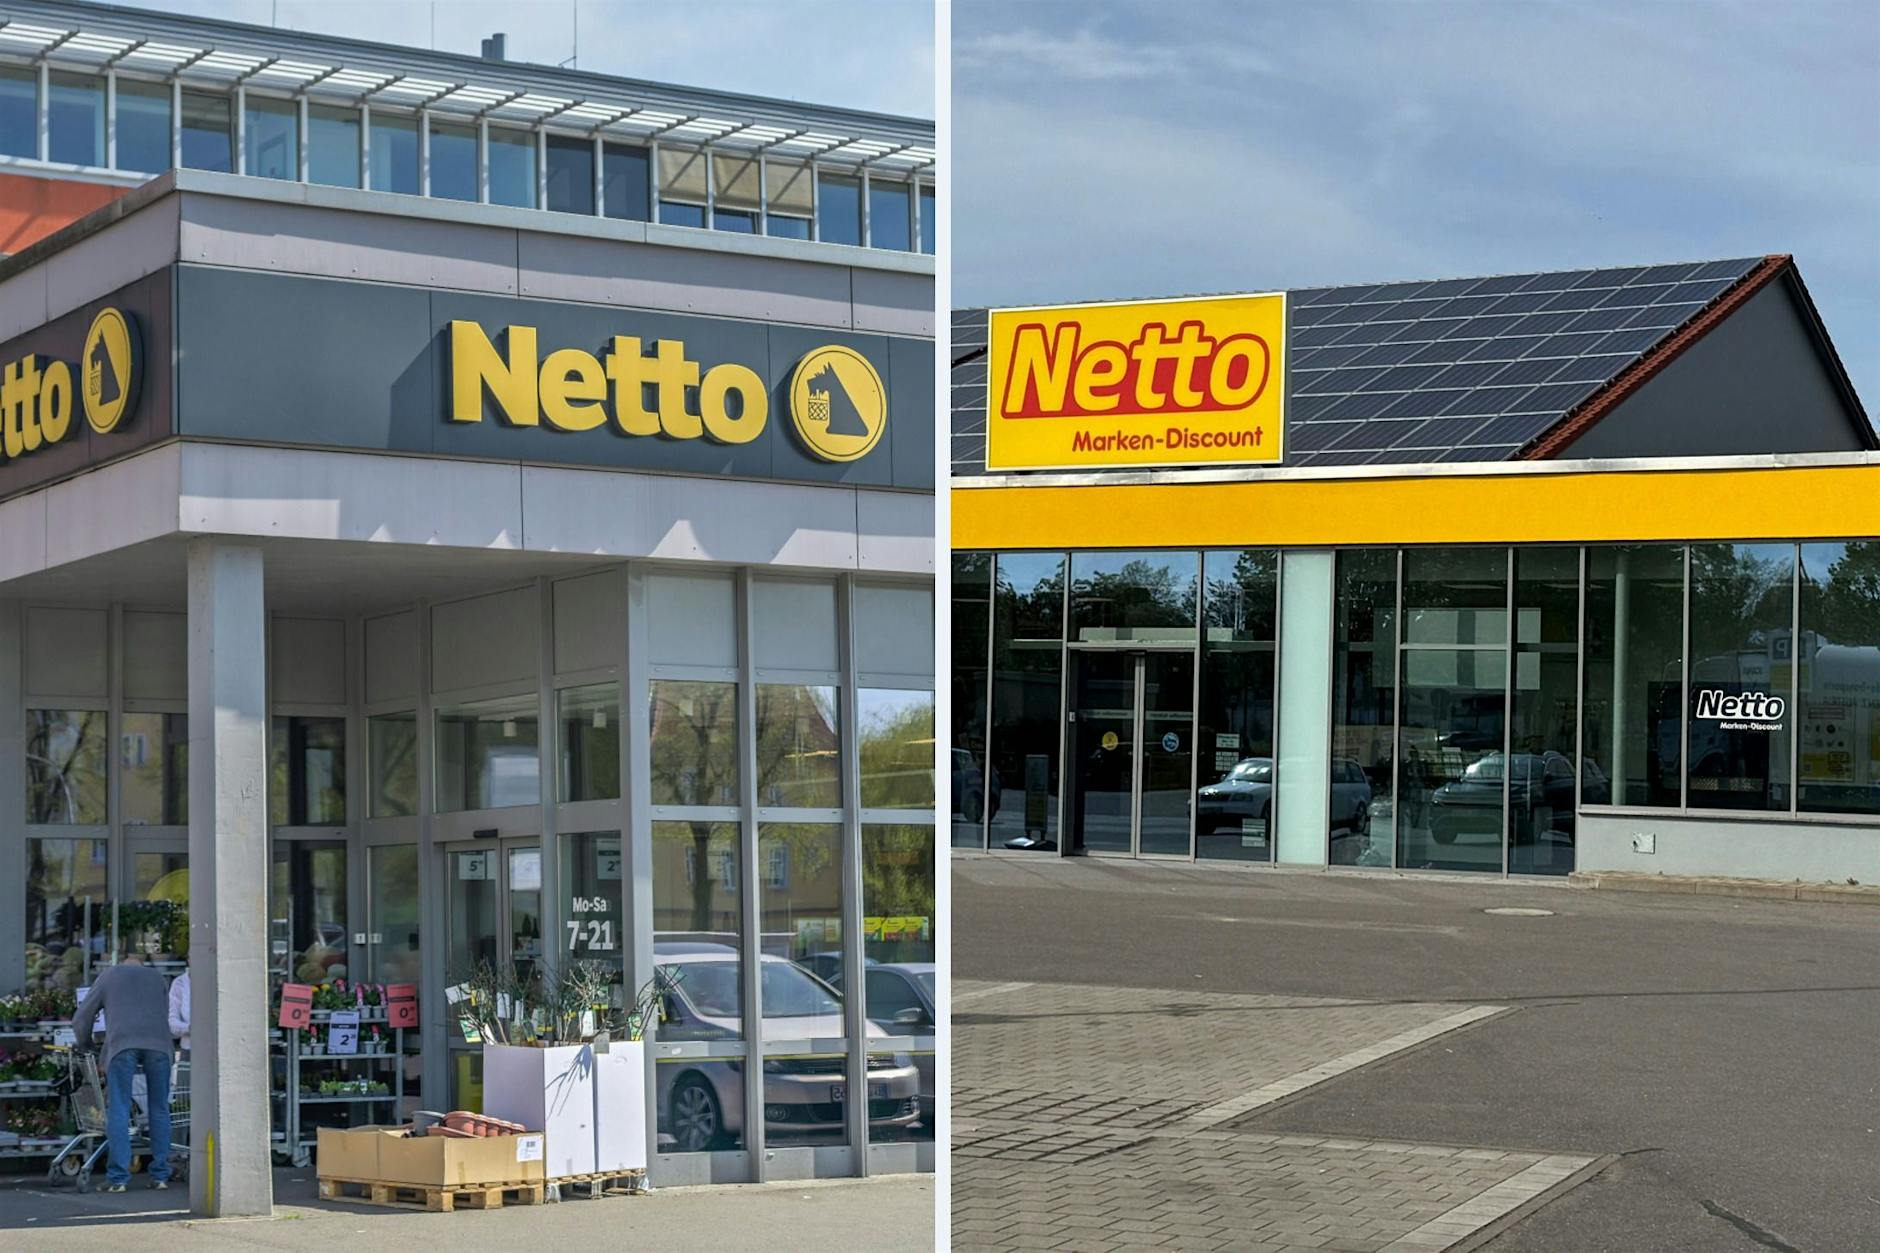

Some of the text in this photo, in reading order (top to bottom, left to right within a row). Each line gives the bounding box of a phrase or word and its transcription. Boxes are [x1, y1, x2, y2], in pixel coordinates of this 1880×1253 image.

[451, 320, 768, 444] Netto
[1001, 320, 1270, 419] Netto
[0, 353, 72, 458] tto
[1072, 426, 1263, 452] Marken-Discount
[1696, 690, 1785, 720] Netto
[1720, 721, 1783, 730] Marken-Discount
[572, 896, 606, 912] Mo-Sa
[566, 920, 614, 950] 7-21
